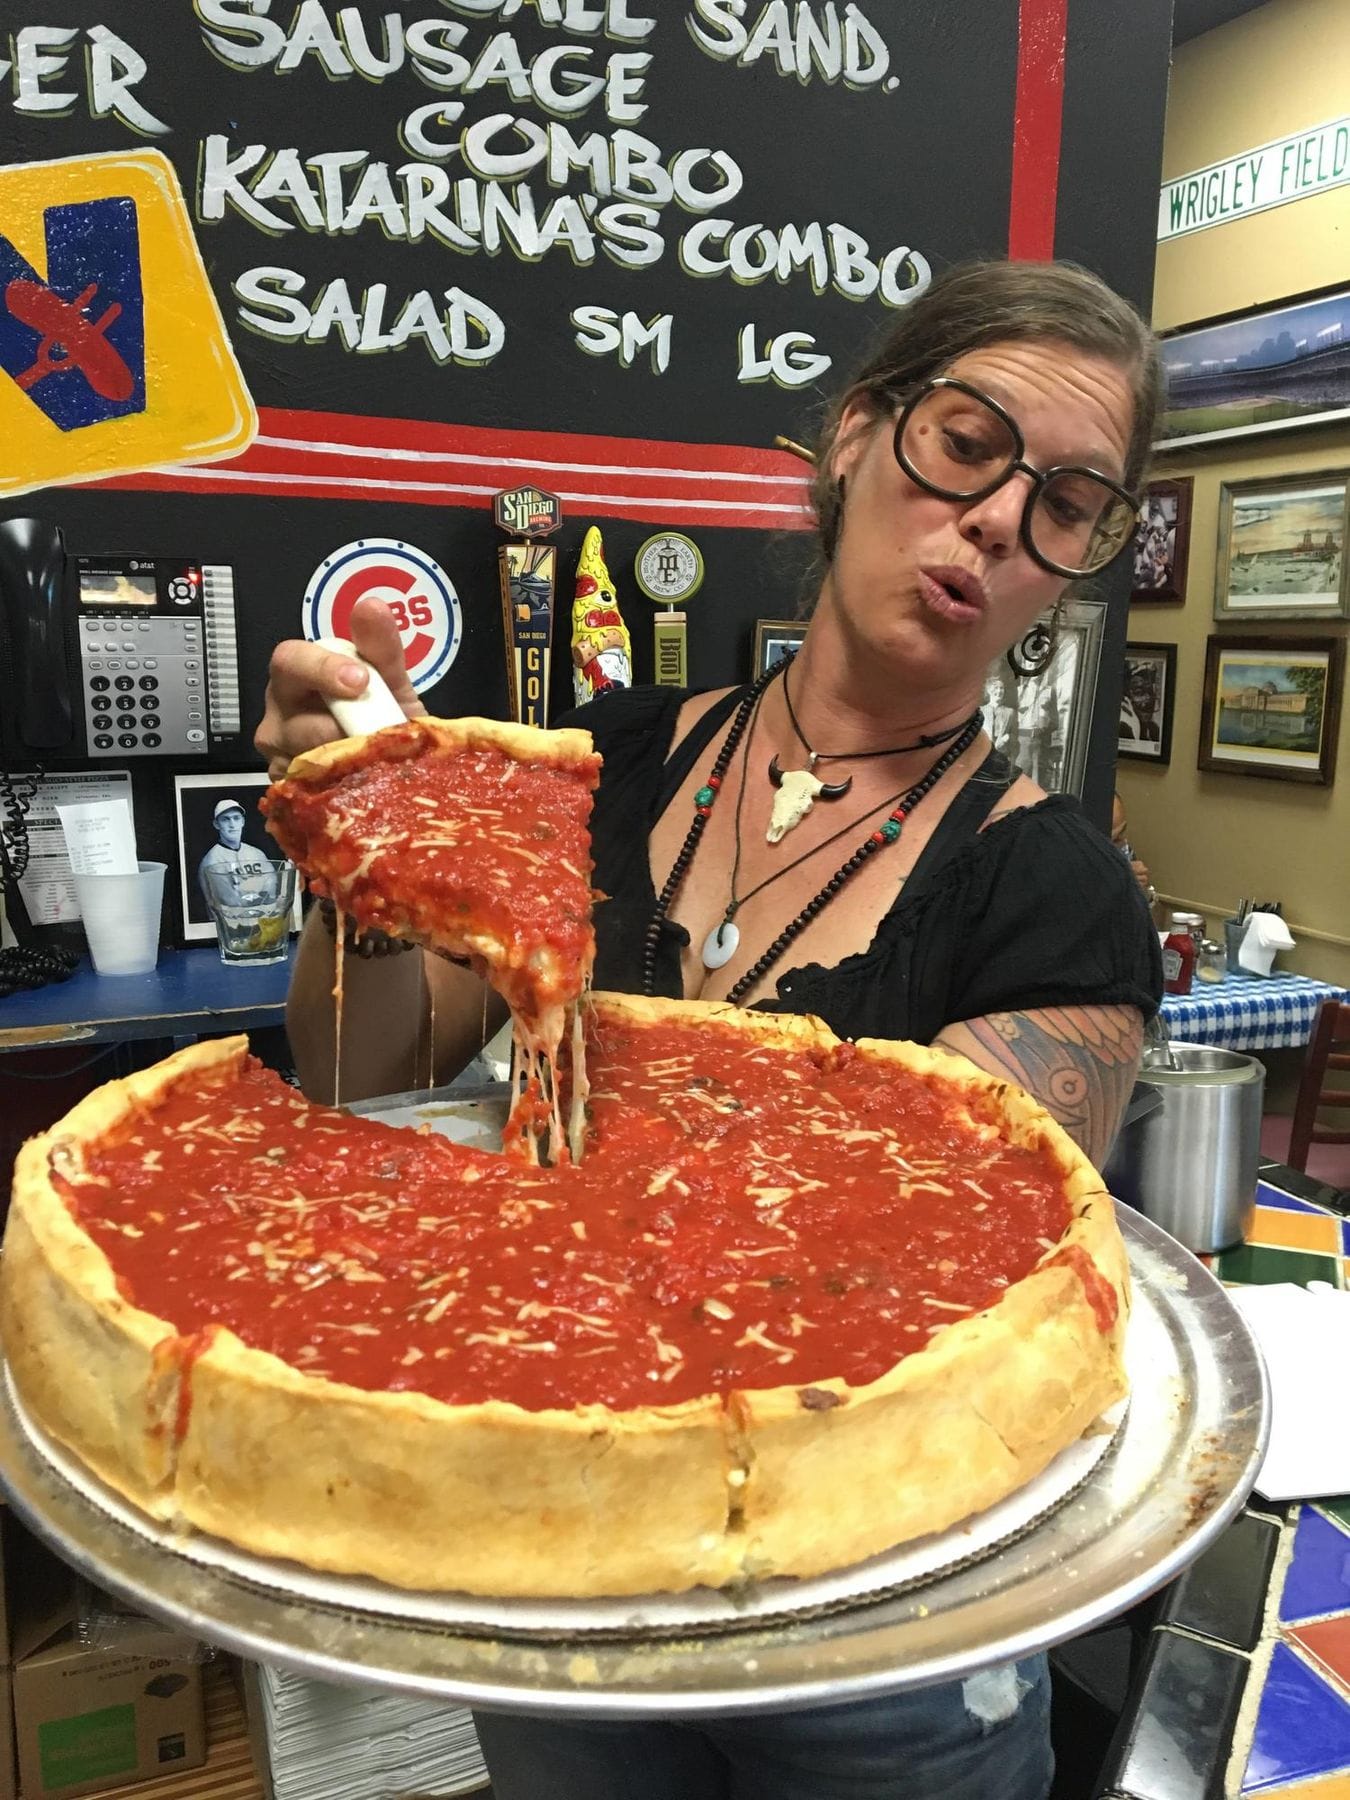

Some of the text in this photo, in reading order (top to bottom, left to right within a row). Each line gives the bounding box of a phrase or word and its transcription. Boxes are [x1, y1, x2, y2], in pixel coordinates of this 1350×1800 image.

[0, 25, 172, 135] ER
[195, 0, 655, 121] SAUSAGE
[684, 0, 901, 90] SAND.
[400, 101, 744, 211] COMBO
[1169, 126, 1349, 232] WRIGLEY FIELD
[201, 134, 933, 305] KATARINA'S COMBO
[231, 265, 832, 387] SALAD SM LG
[503, 490, 532, 521] SAN
[516, 499, 554, 530] DIEGO
